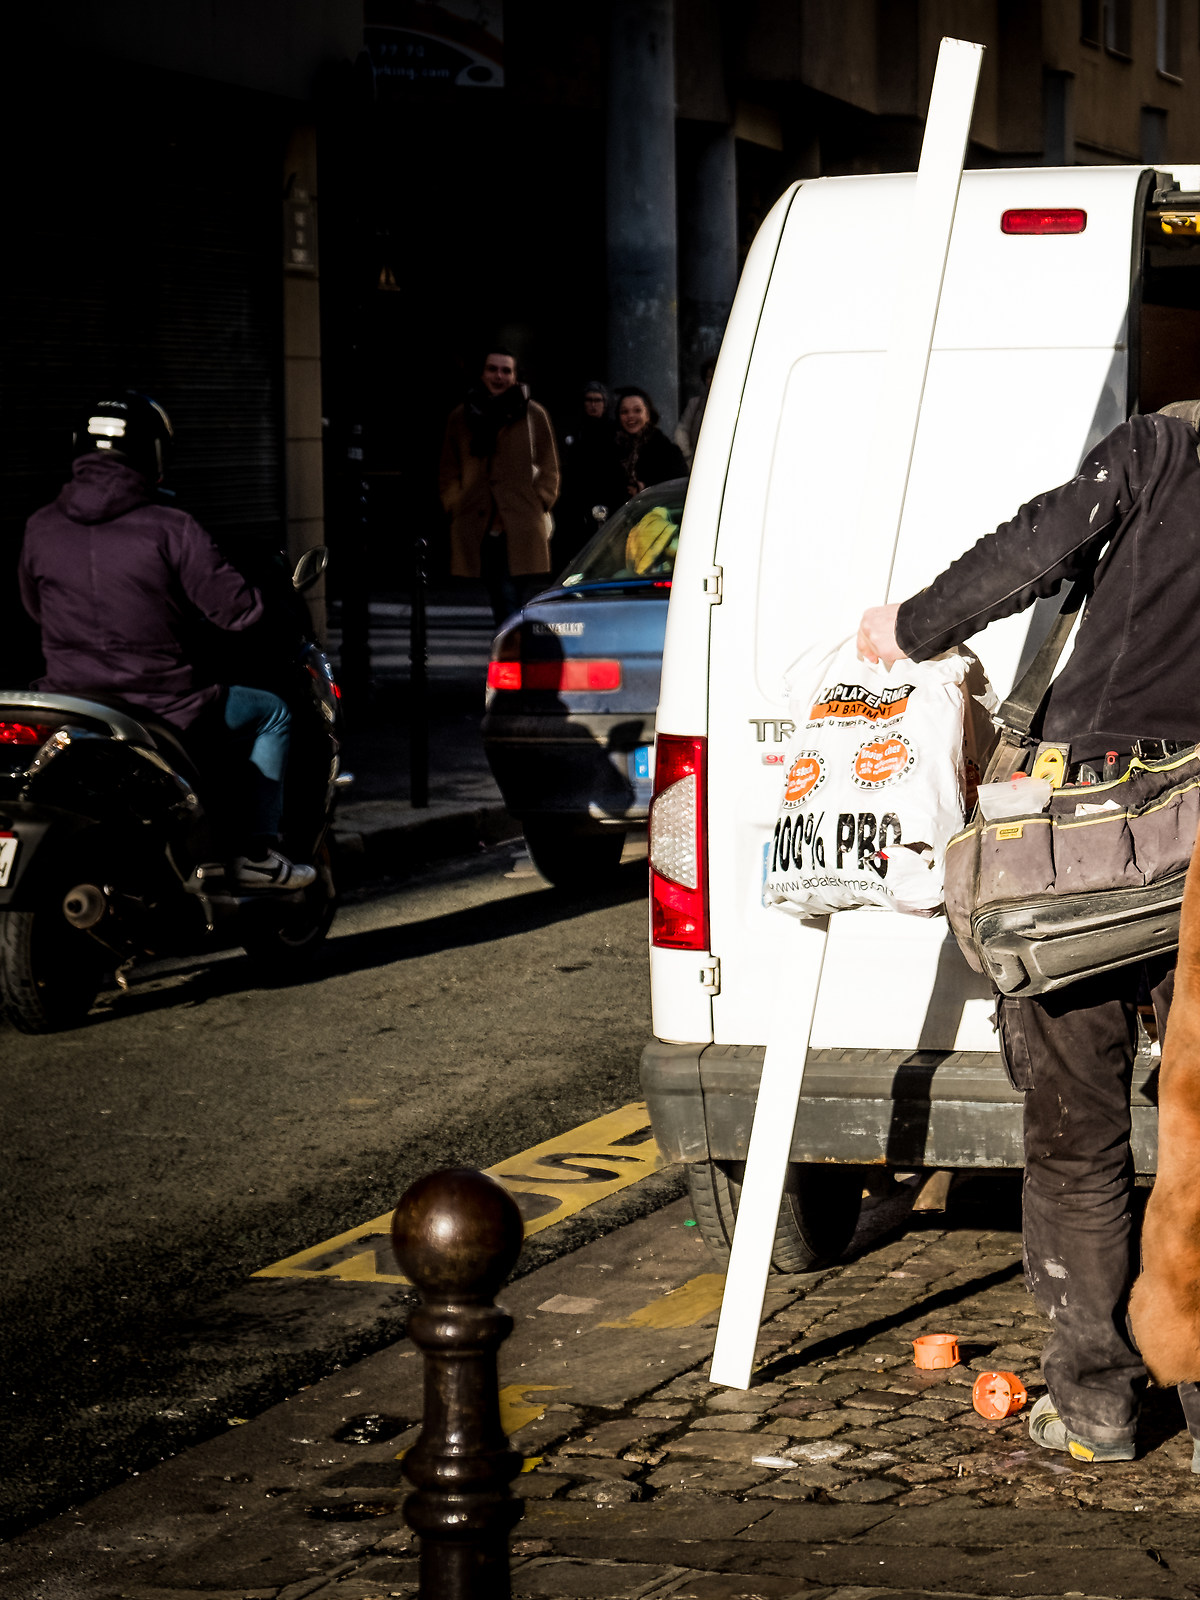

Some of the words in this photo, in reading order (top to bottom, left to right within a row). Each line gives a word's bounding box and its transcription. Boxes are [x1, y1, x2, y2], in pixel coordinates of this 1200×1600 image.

[842, 703, 893, 719] BATIMNT
[748, 719, 797, 742] TR
[772, 811, 826, 872] 100%
[836, 812, 902, 879] PRO
